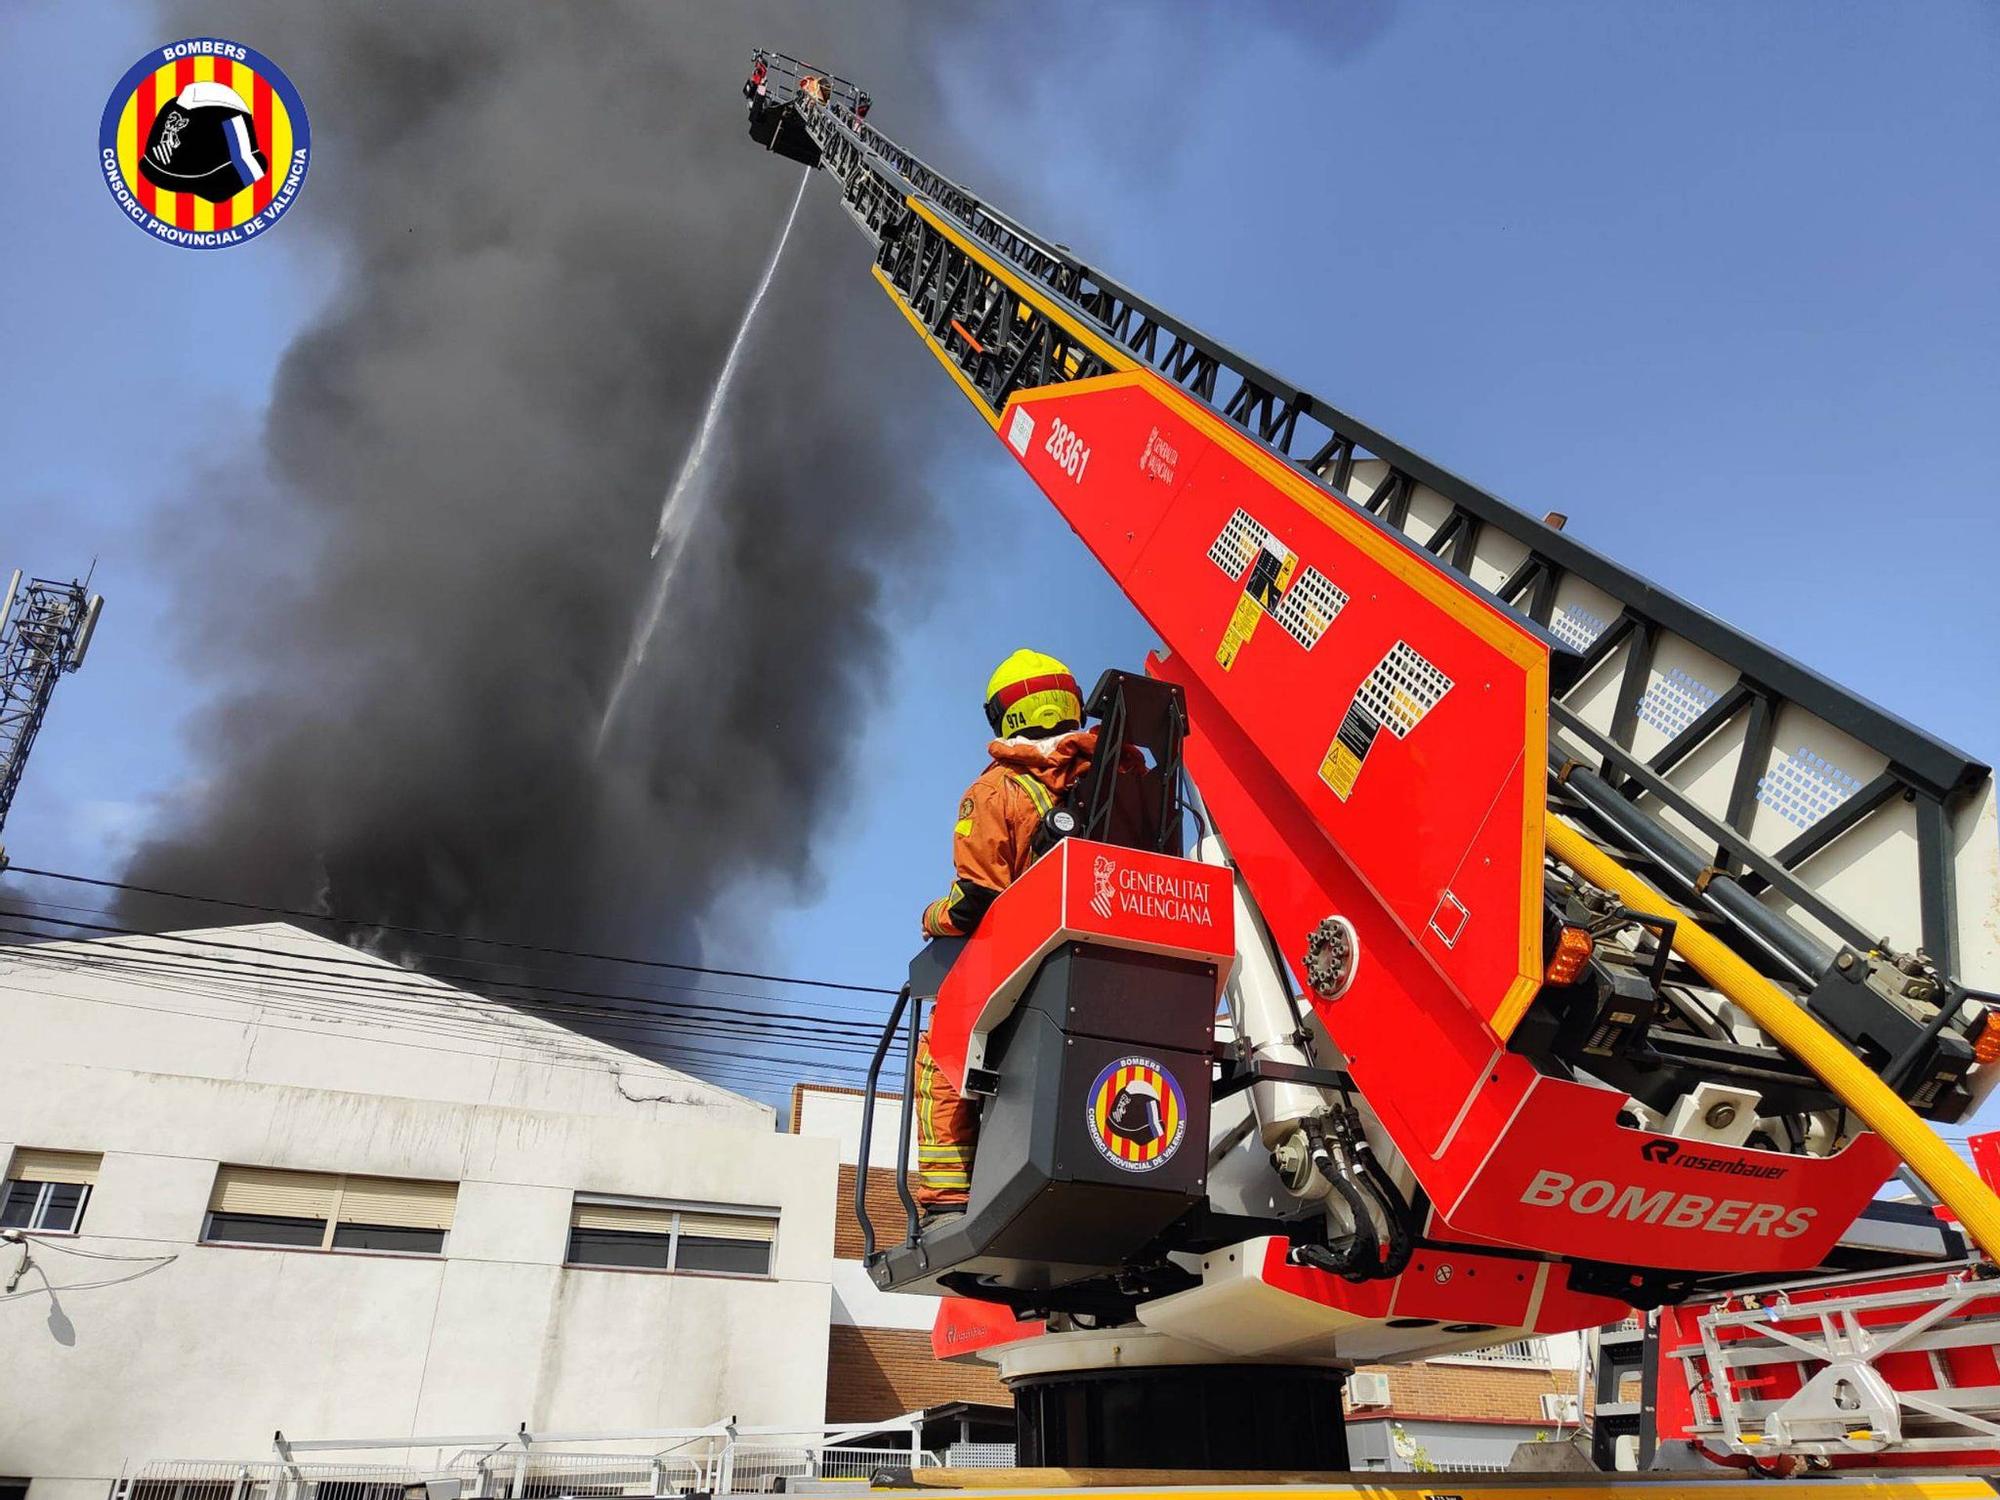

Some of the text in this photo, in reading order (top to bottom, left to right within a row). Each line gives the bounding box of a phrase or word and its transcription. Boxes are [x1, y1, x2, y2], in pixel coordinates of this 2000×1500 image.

[1044, 416, 1091, 484] 28361
[1006, 711, 1027, 729] 974
[1119, 868, 1210, 903] GENERALITAT
[1119, 891, 1213, 927] VALENCIANA
[1120, 1058, 1161, 1072] BOMBERS
[1088, 1108, 1185, 1169] CONSORCI PROVINCIAL DE VALENCIA
[1673, 1152, 1789, 1180] rosenbauer
[1519, 1169, 1819, 1239] BOMBERS
